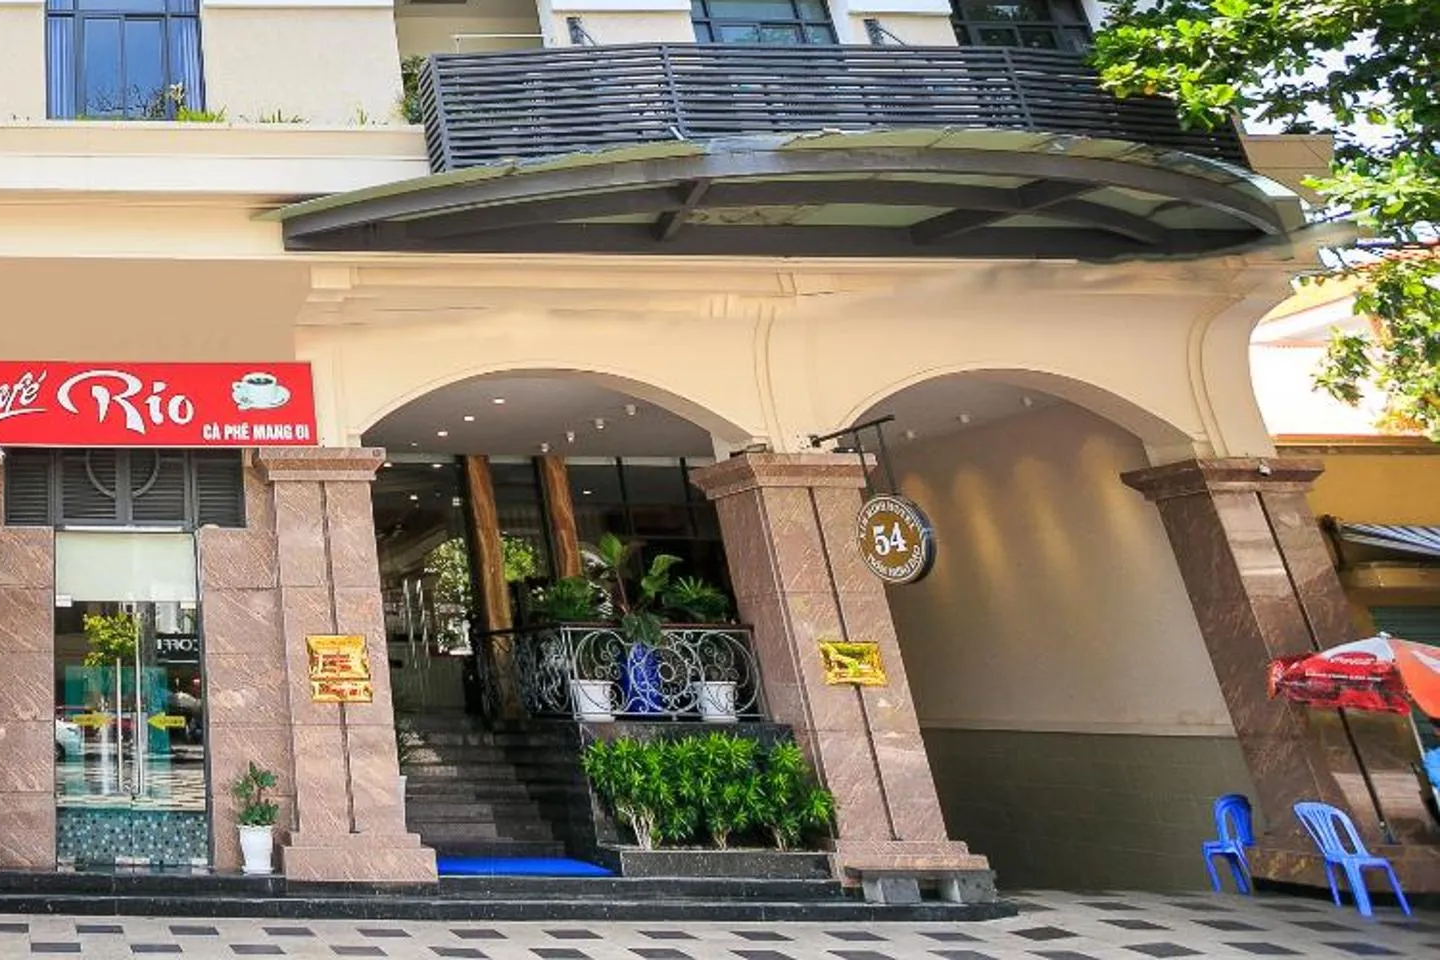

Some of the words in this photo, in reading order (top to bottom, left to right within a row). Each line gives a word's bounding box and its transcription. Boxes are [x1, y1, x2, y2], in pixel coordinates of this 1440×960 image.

[56, 369, 194, 435] Rio
[253, 424, 293, 440] MANG
[873, 522, 908, 555] 54
